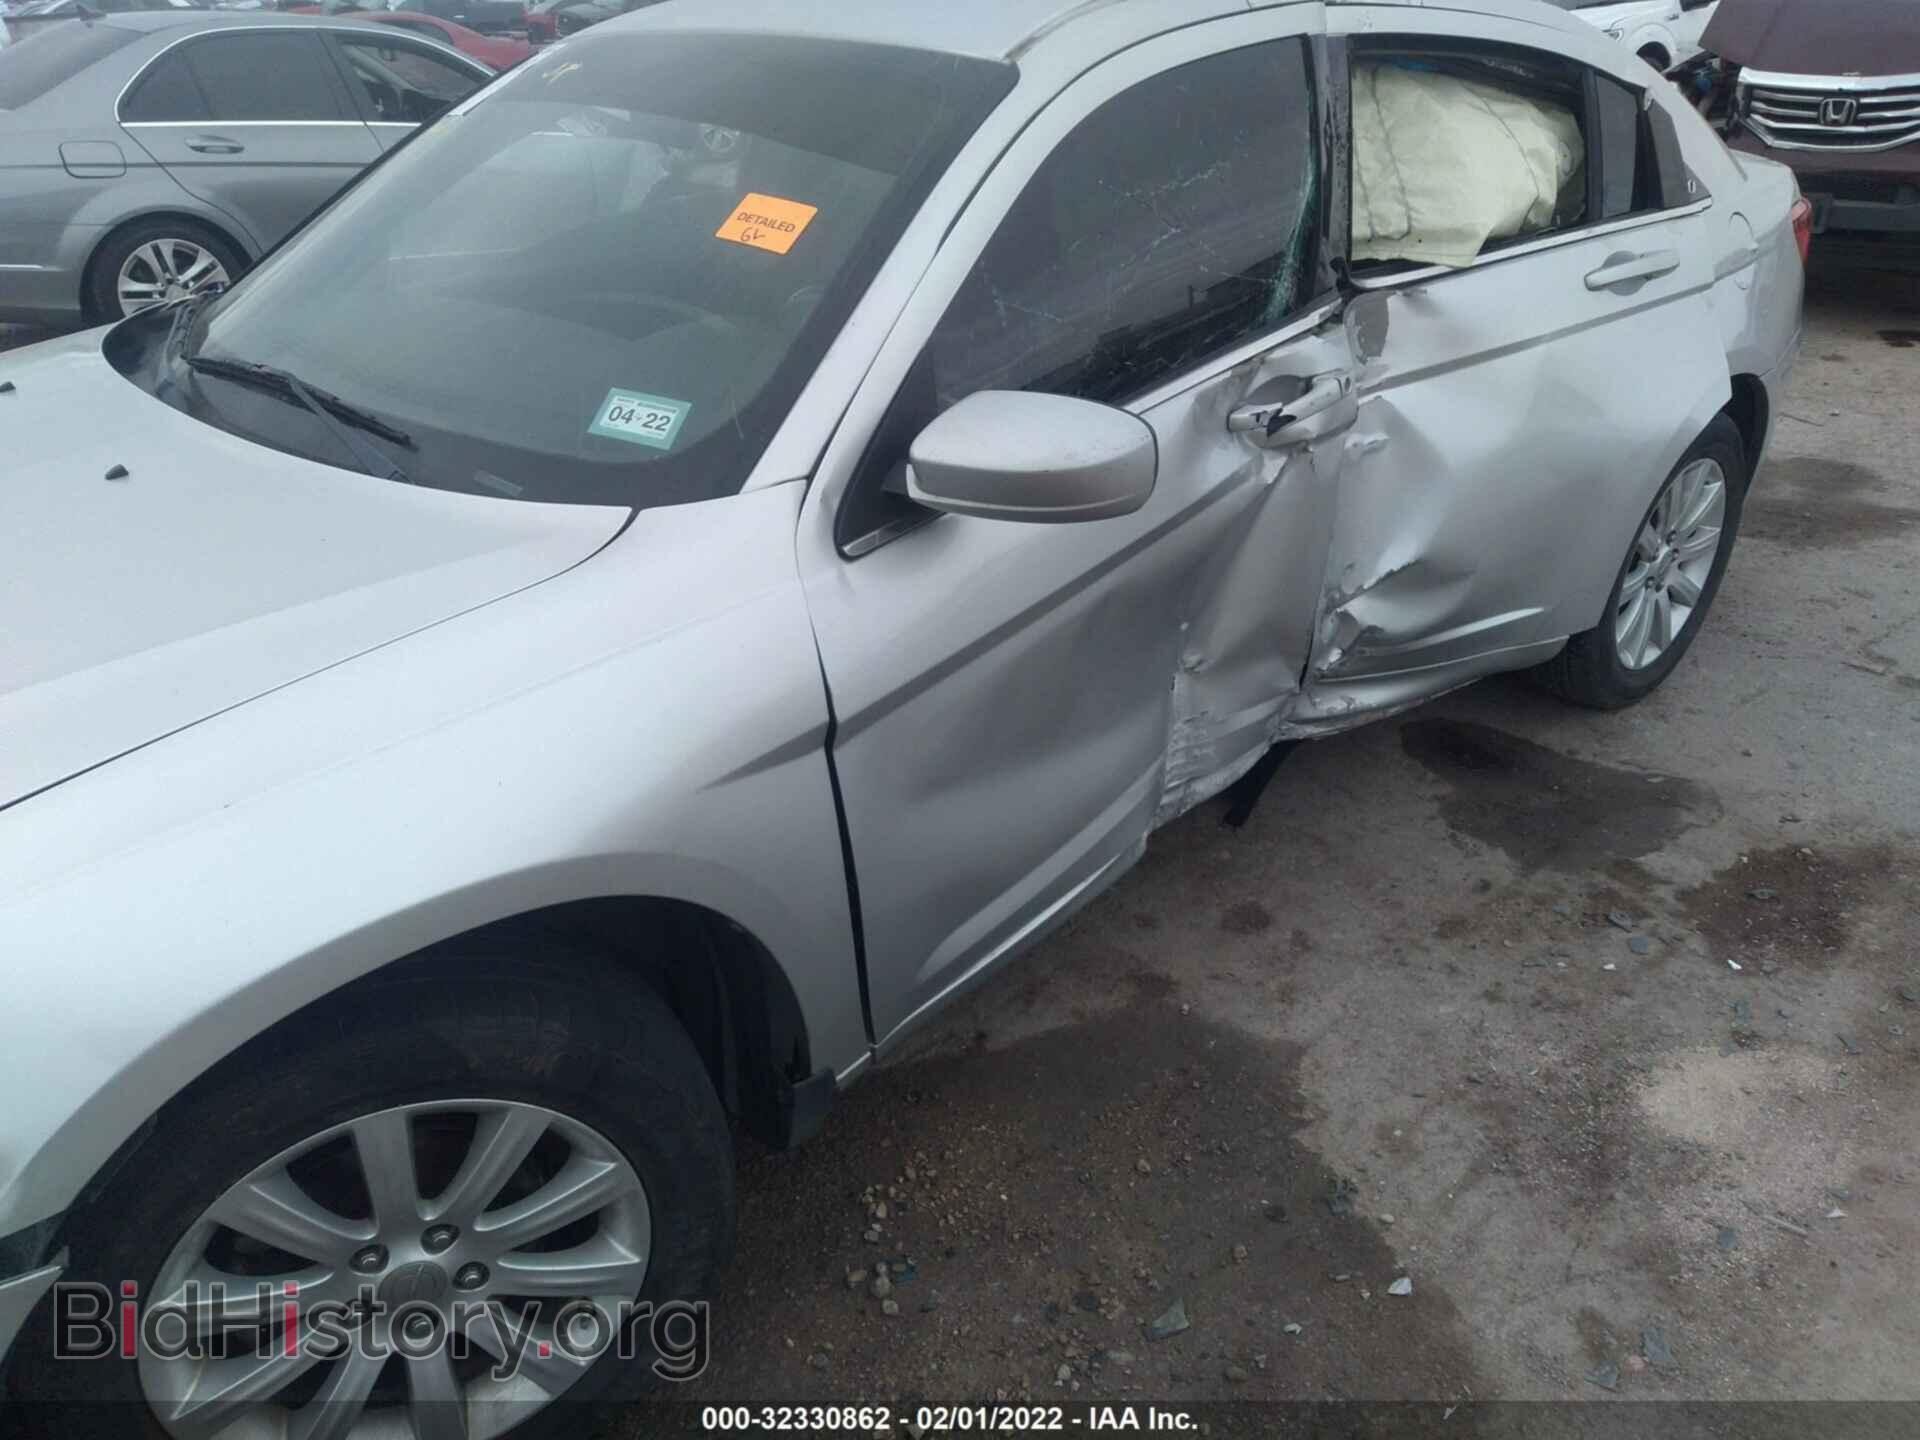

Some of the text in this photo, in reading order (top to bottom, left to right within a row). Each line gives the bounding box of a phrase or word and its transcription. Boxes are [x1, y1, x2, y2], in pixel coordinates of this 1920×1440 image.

[737, 212, 796, 233] DETAILED
[608, 405, 636, 424] 04
[642, 412, 672, 432] 22
